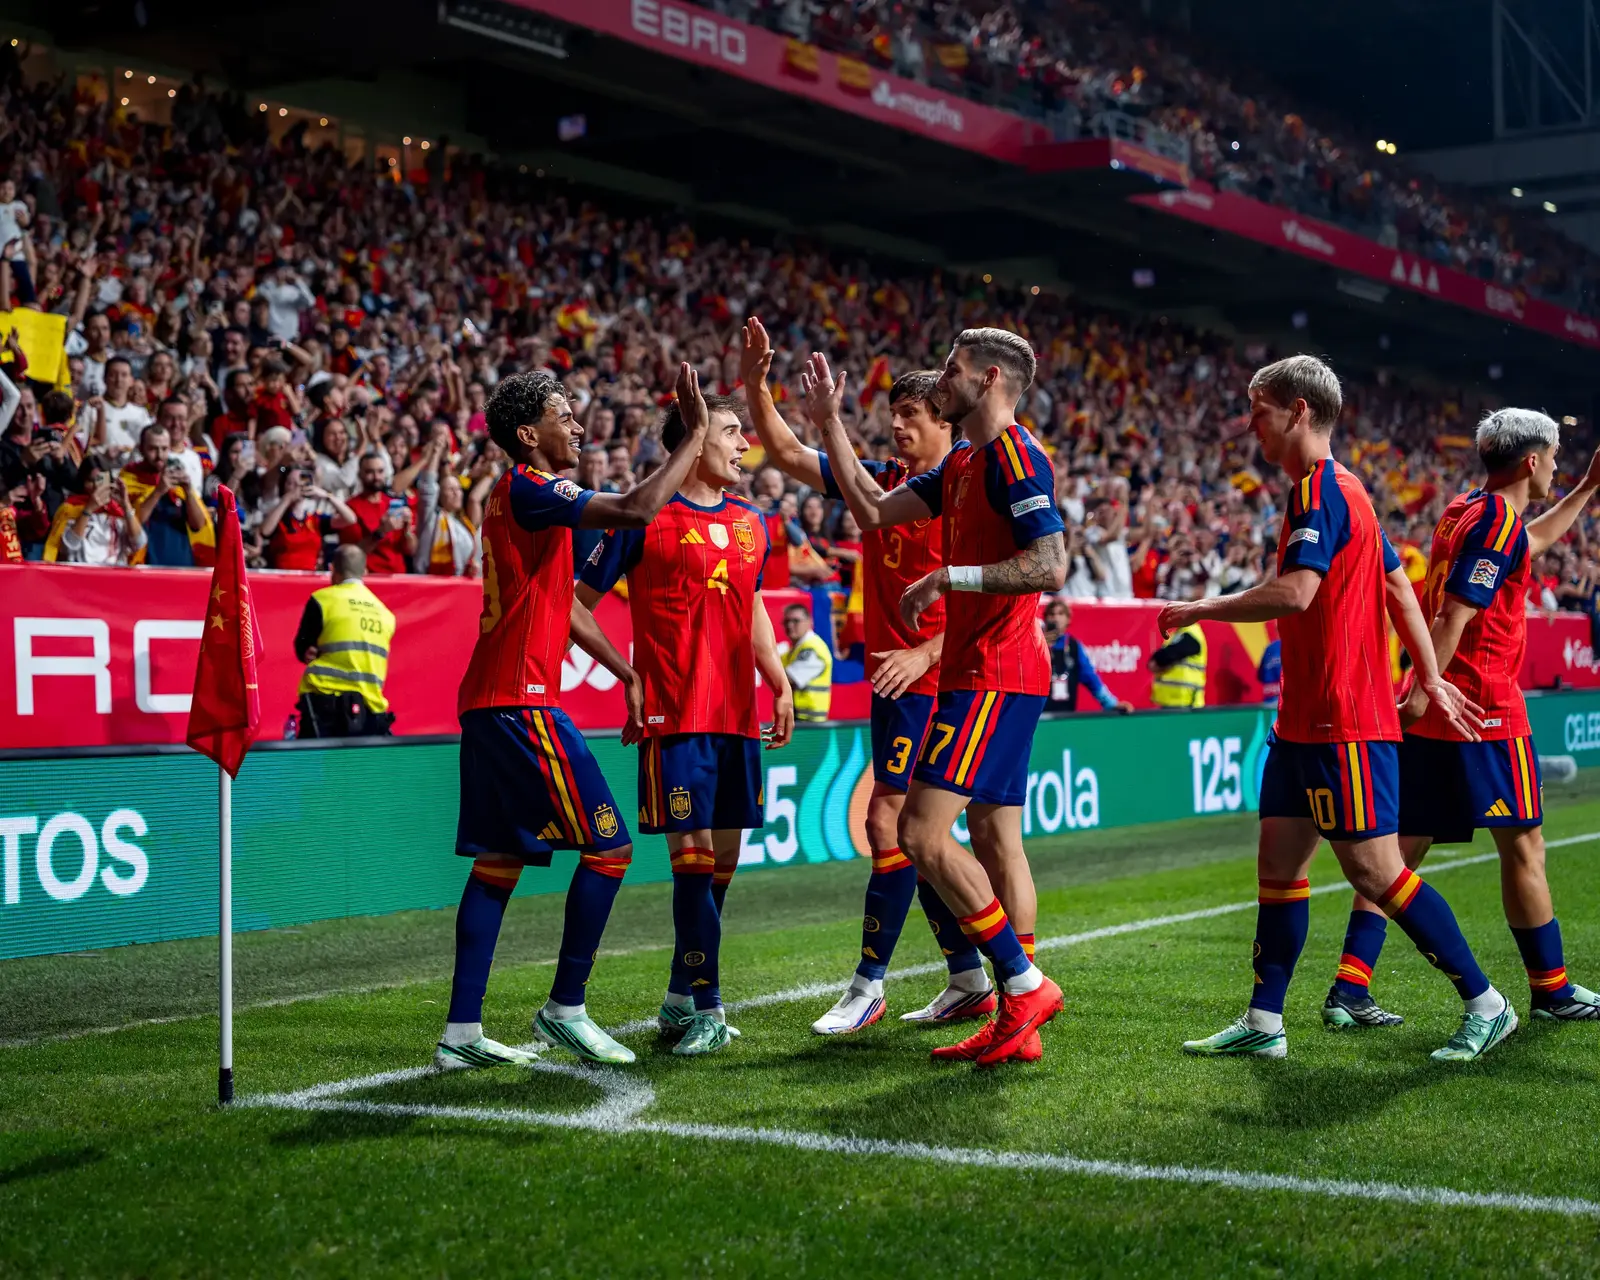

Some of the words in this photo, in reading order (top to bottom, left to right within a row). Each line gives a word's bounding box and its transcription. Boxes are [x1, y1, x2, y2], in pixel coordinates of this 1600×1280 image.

[631, 0, 746, 65] EBRO
[883, 532, 902, 569] 3
[707, 559, 729, 595] 4
[360, 616, 382, 634] 023
[886, 736, 912, 774] 3
[917, 721, 956, 765] 17
[1189, 736, 1242, 814] 125
[1306, 788, 1336, 830] 10
[0, 808, 150, 905] TOS
